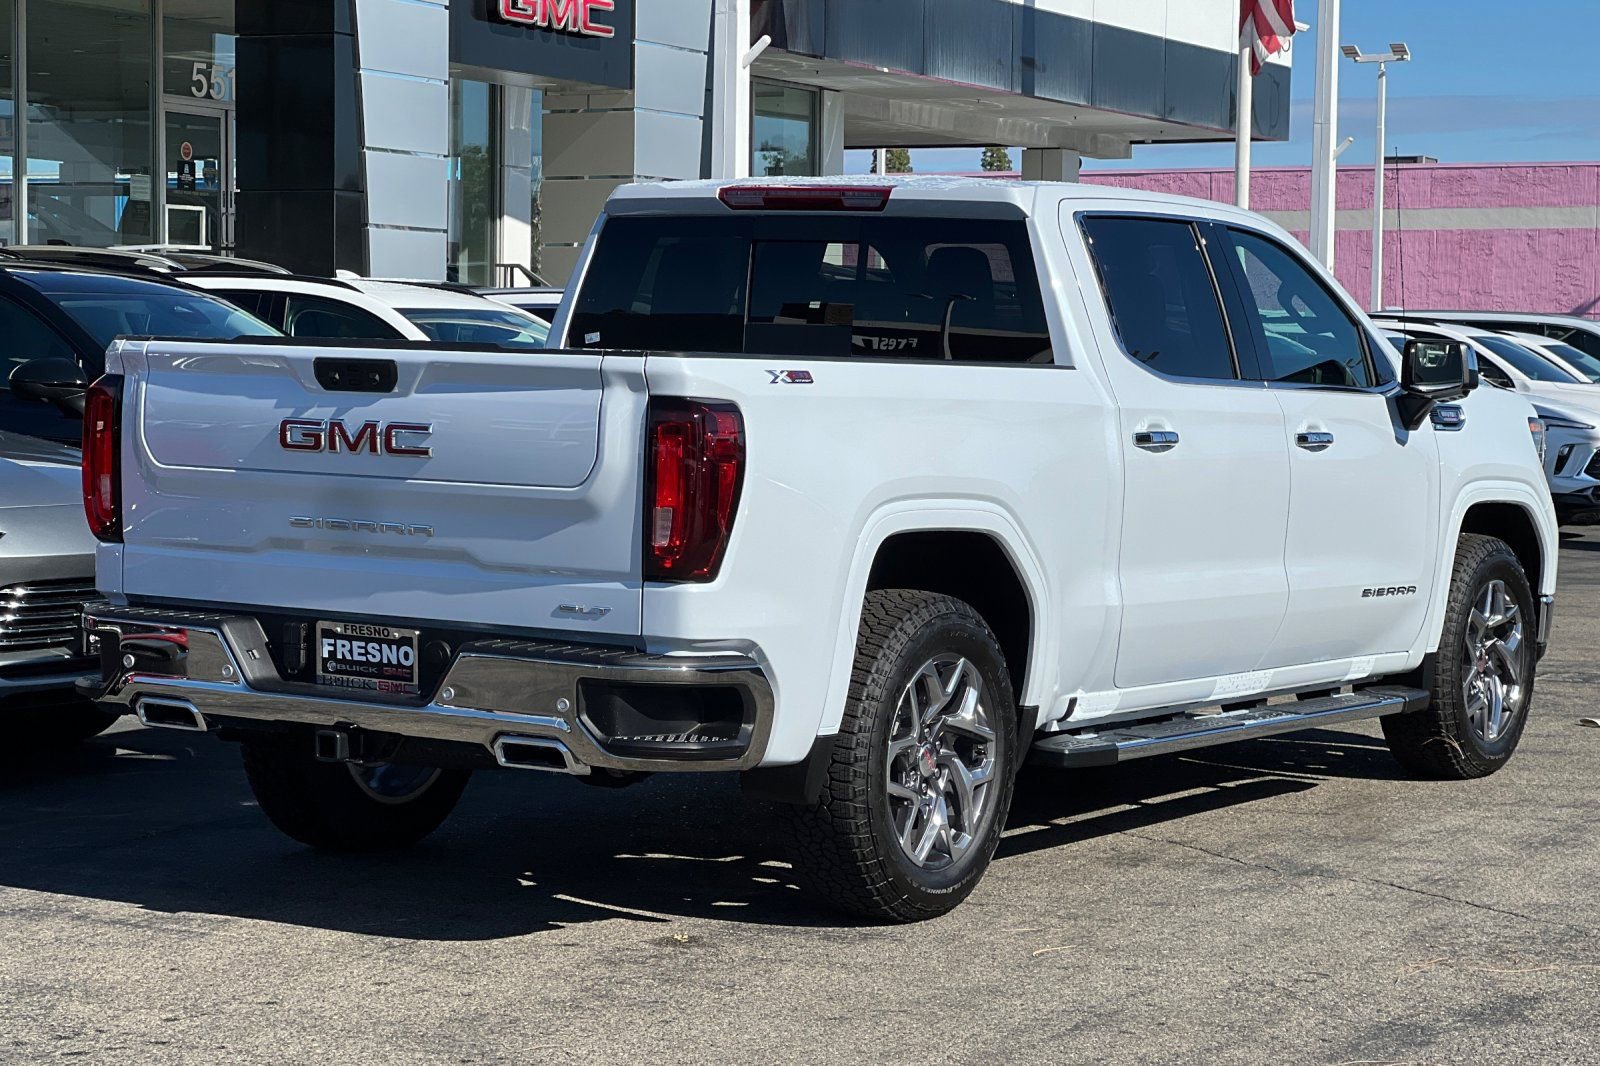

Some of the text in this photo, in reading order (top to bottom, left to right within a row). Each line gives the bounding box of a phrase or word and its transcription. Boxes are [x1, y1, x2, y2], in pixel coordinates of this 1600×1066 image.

[499, 0, 615, 37] GMC
[279, 416, 433, 458] GMC
[289, 516, 434, 537] SIERRA
[1361, 585, 1417, 598] SIERRA
[343, 624, 391, 638] FRESNO
[322, 638, 414, 666] FRESNO
[337, 663, 378, 674] BUICK
